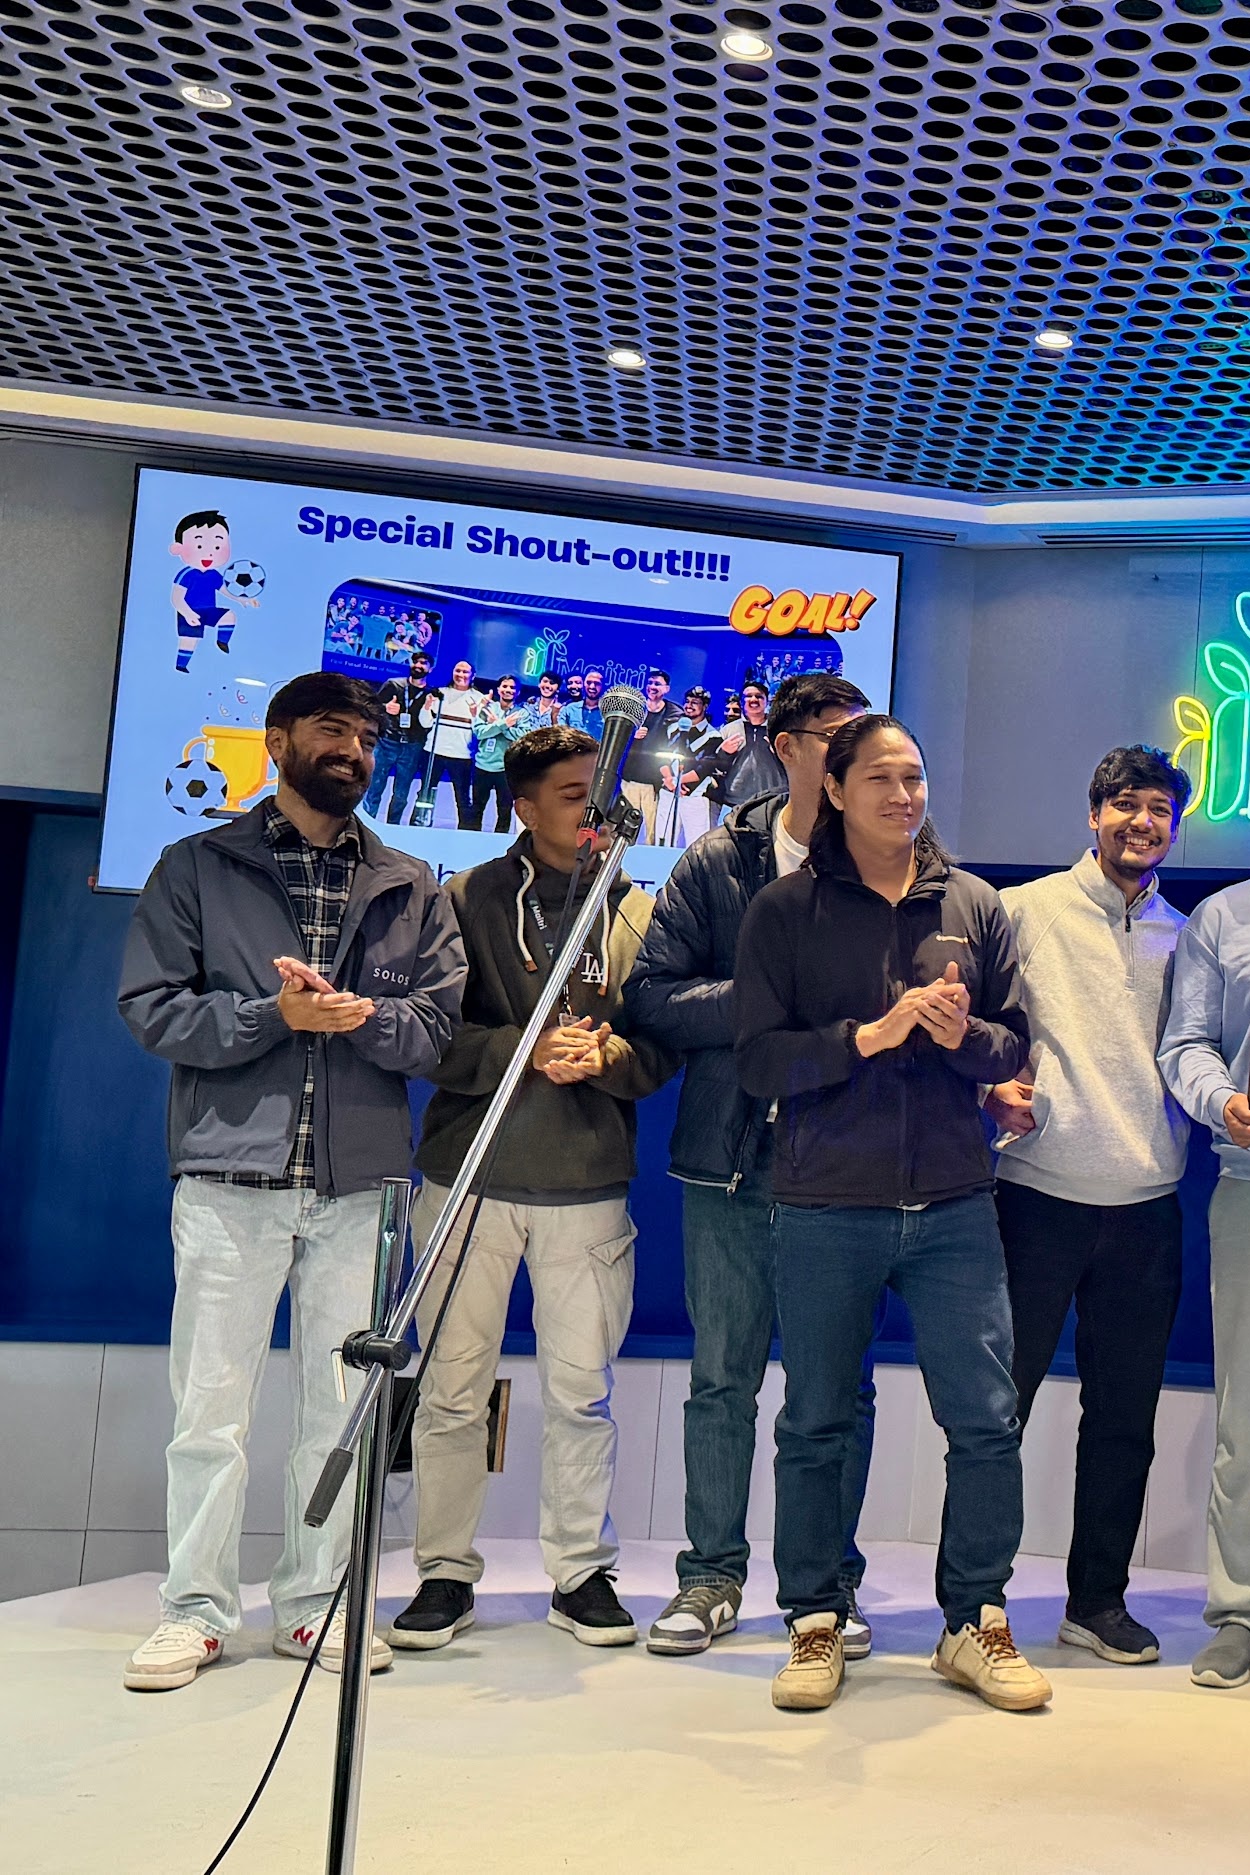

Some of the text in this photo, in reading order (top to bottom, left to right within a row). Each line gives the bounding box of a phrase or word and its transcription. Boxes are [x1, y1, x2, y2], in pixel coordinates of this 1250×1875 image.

[297, 506, 731, 582] Special Shout-out!!!!
[729, 584, 877, 636] GOAL!
[531, 905, 548, 931] Maitri
[373, 967, 410, 986] SOLOS
[580, 952, 604, 983] LA
